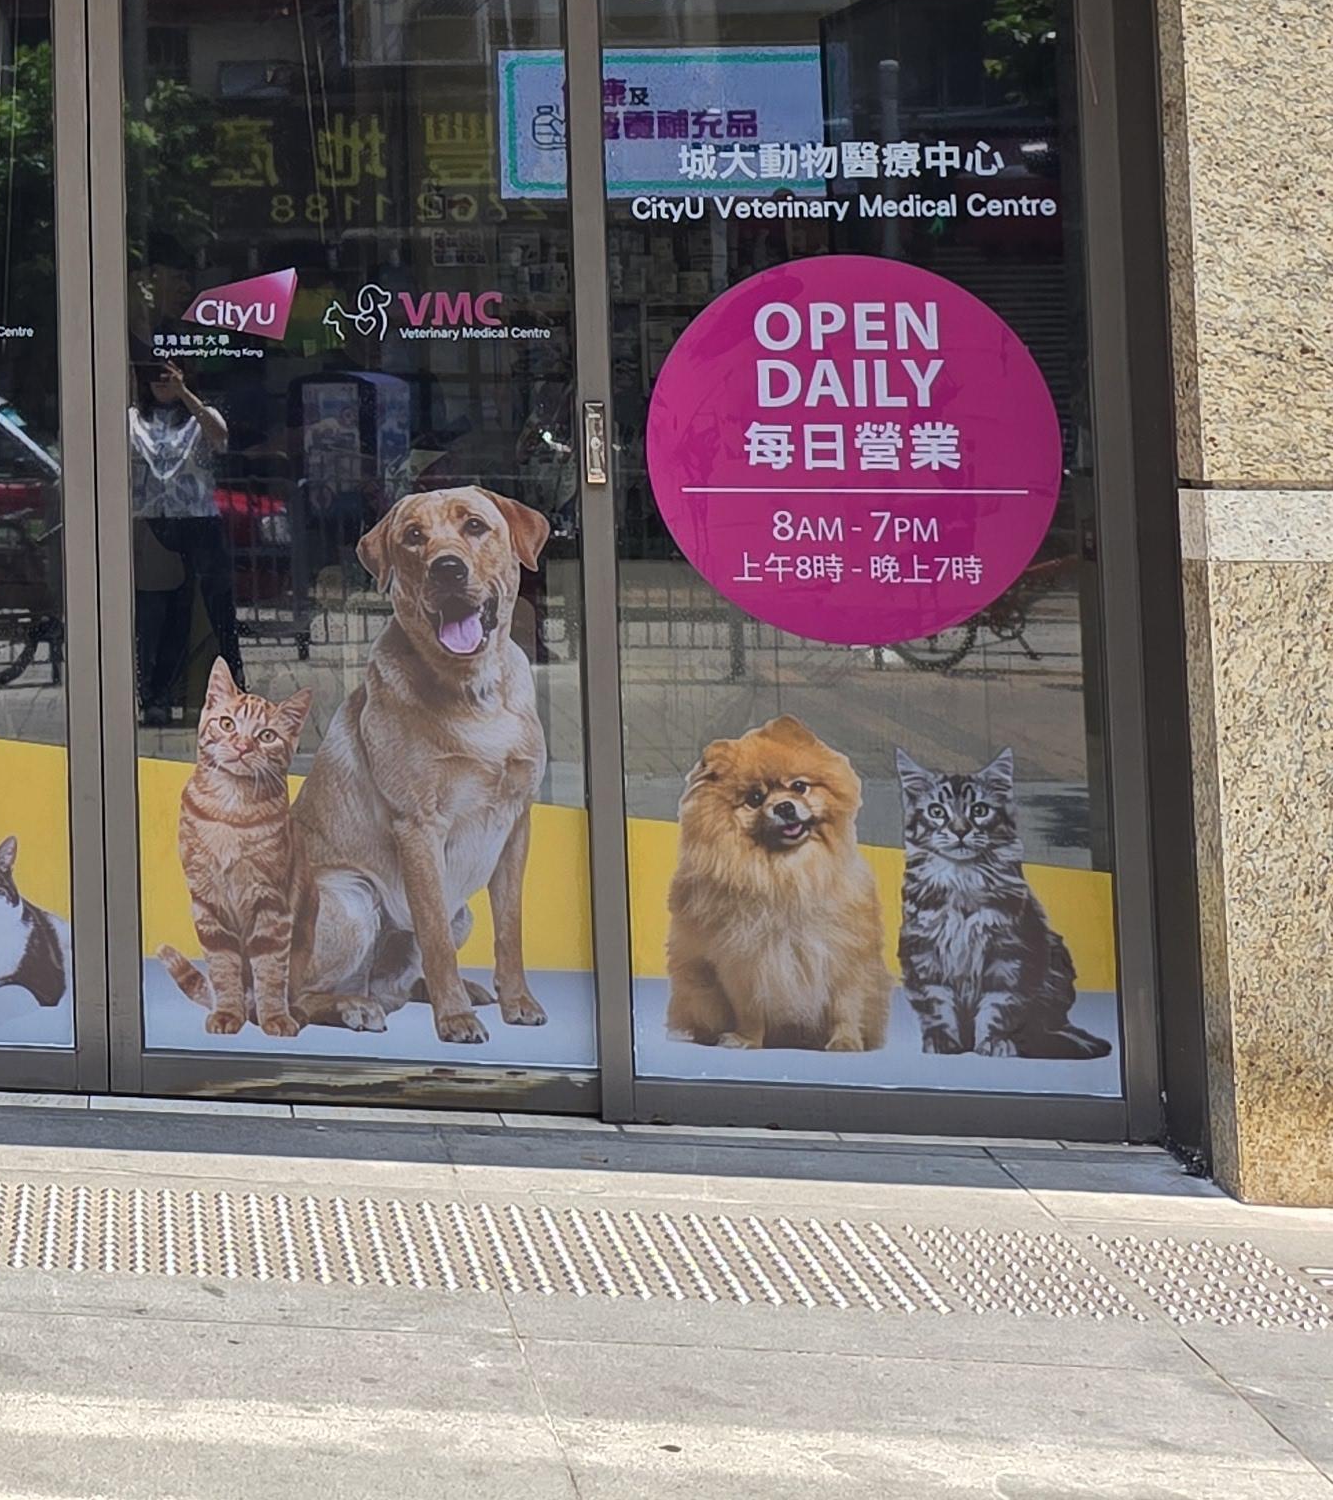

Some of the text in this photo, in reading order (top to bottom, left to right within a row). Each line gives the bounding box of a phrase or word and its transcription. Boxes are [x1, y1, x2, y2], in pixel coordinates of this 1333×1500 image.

[678, 140, 1005, 180] 城大動物醫療中心
[632, 191, 1057, 222] CityU Veterinary Medical Centre
[195, 299, 276, 331] CityU
[398, 291, 503, 326] VMC
[153, 334, 230, 346] 香港城市大學
[399, 326, 551, 341] Veterinary Medical Centre
[753, 301, 940, 351] OPEN
[153, 348, 170, 359] City
[210, 347, 219, 357] of
[219, 348, 242, 358] Hong
[242, 348, 264, 358] Kong
[756, 359, 945, 408] DAILY
[743, 421, 962, 471] 每日營業
[772, 510, 844, 542] 8AM
[869, 510, 940, 543] 7PM
[733, 551, 844, 583] 上午8時
[869, 553, 983, 585] 晚上7時
